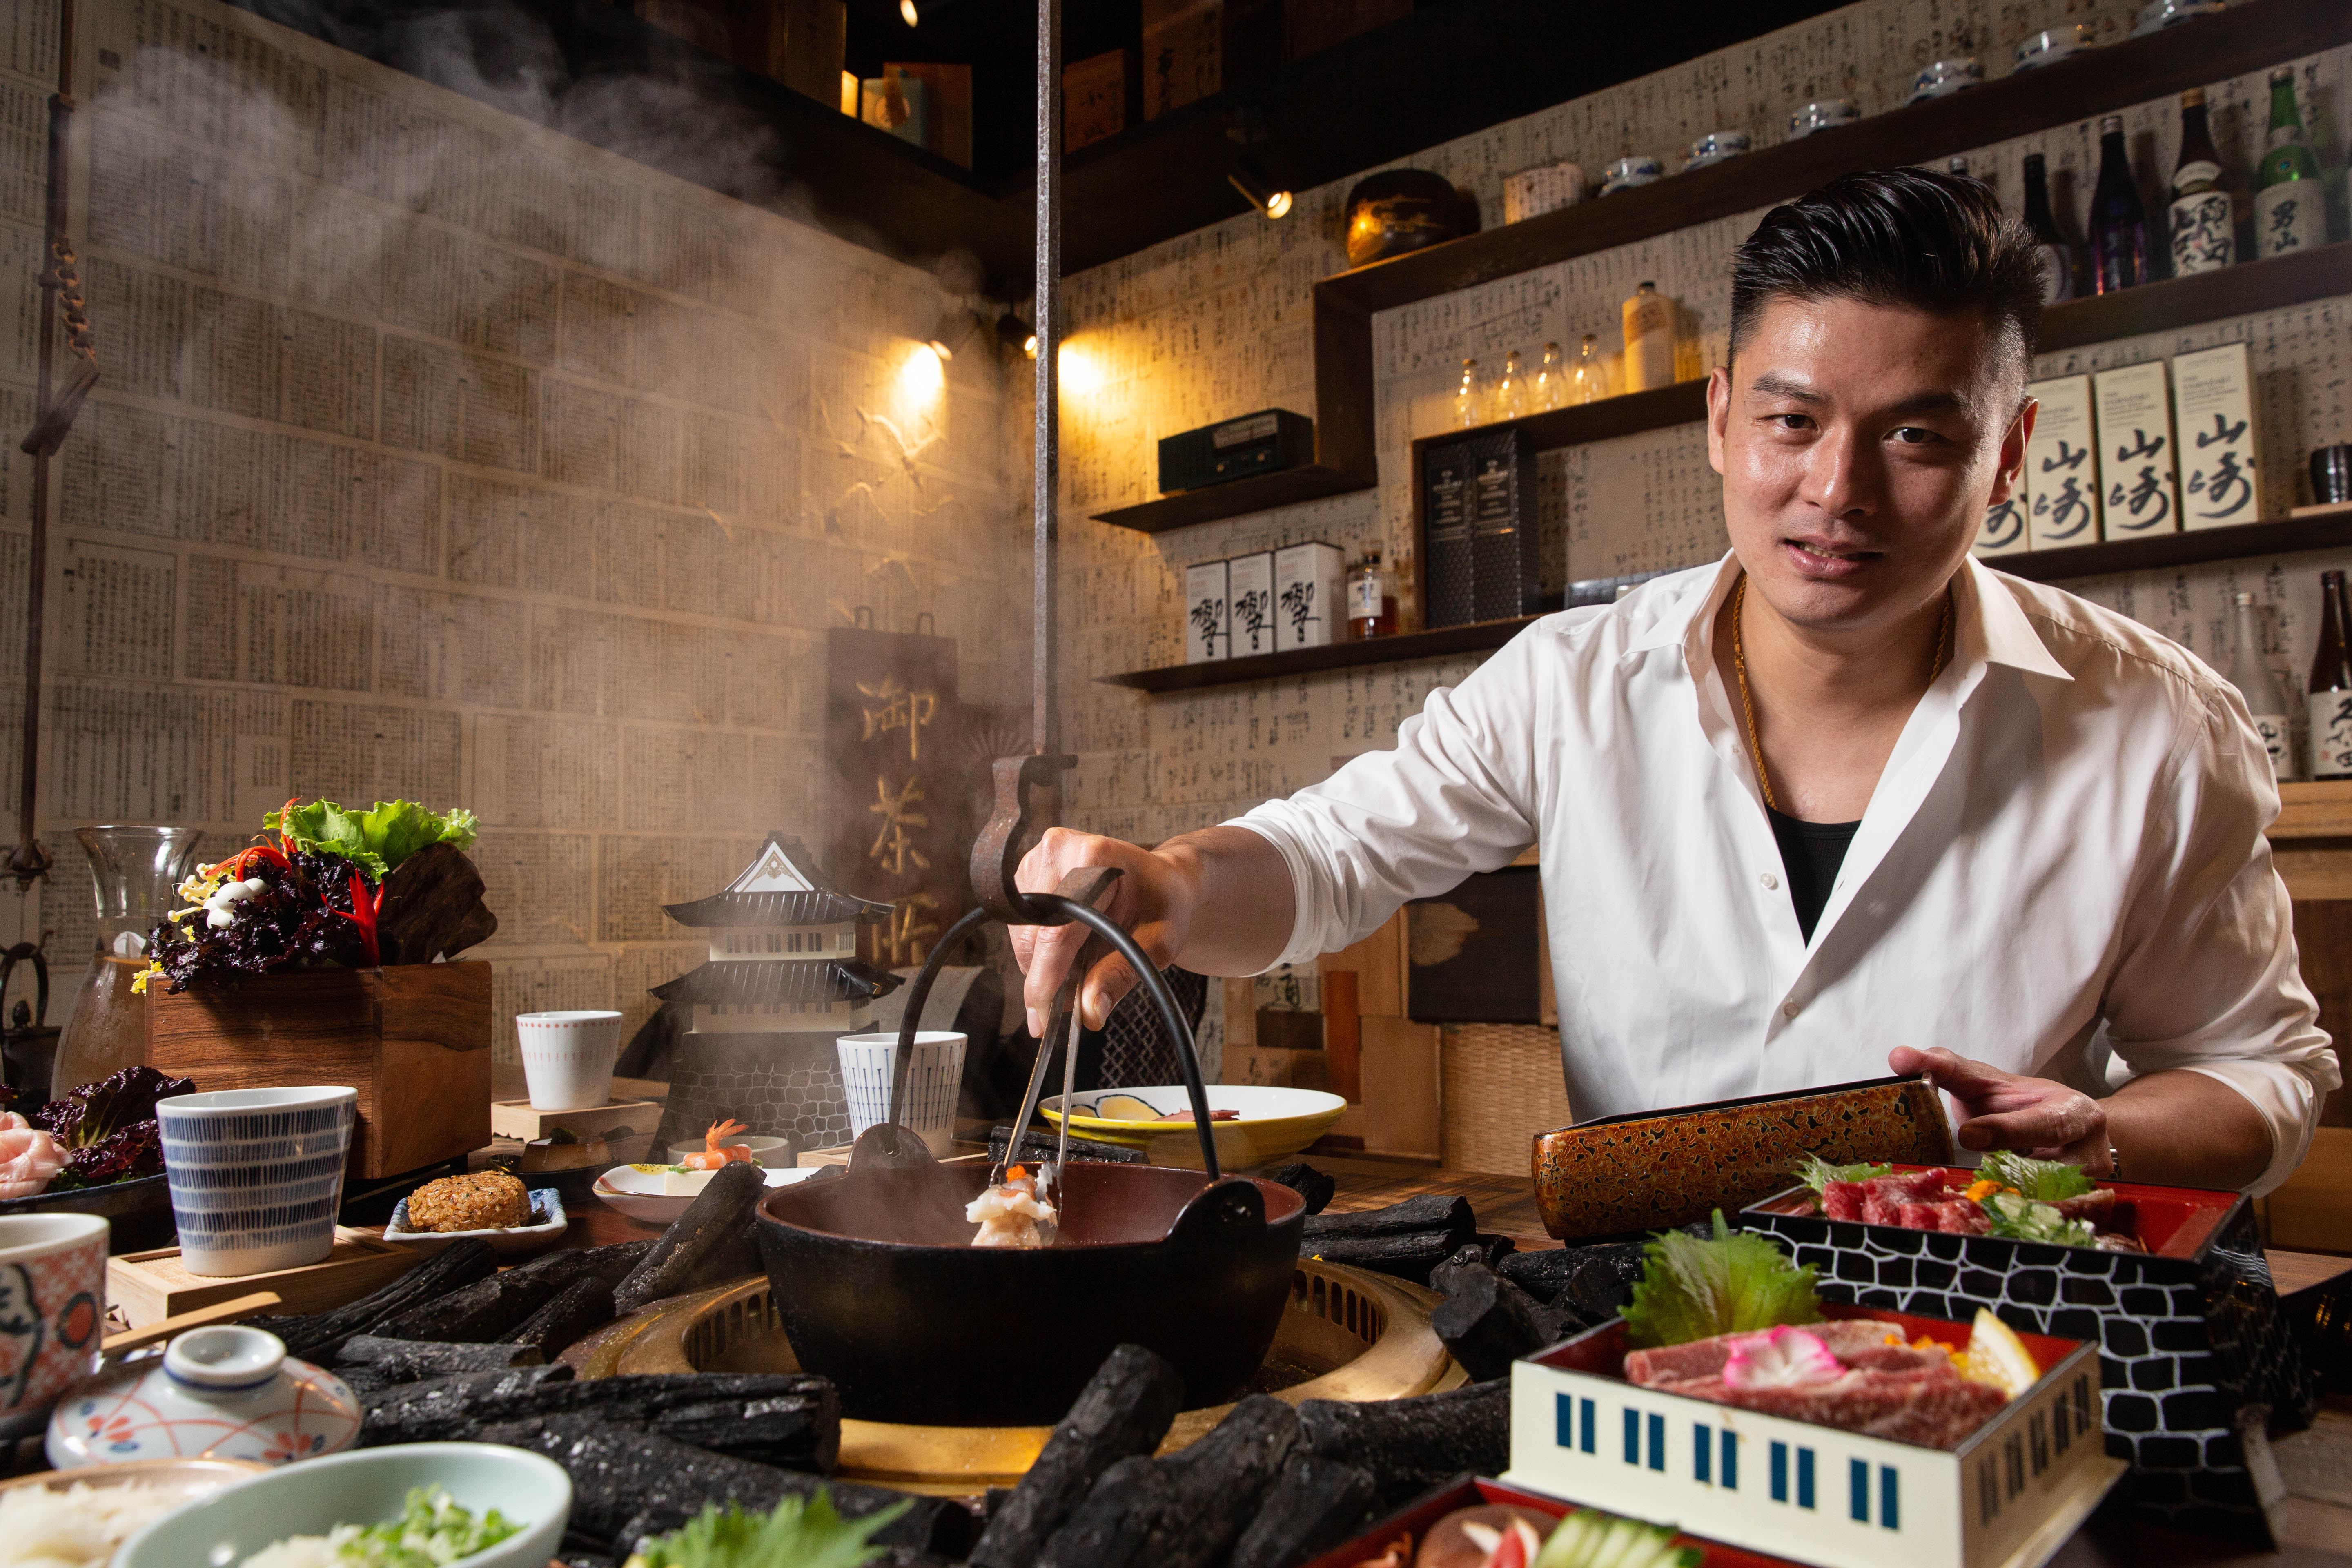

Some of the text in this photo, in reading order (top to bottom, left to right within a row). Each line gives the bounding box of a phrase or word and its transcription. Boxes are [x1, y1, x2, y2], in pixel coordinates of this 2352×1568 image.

[2270, 199, 2300, 252] 男山
[2034, 440, 2095, 540] 山崎
[2109, 428, 2174, 530] 山崎
[2187, 413, 2256, 519] 山崎
